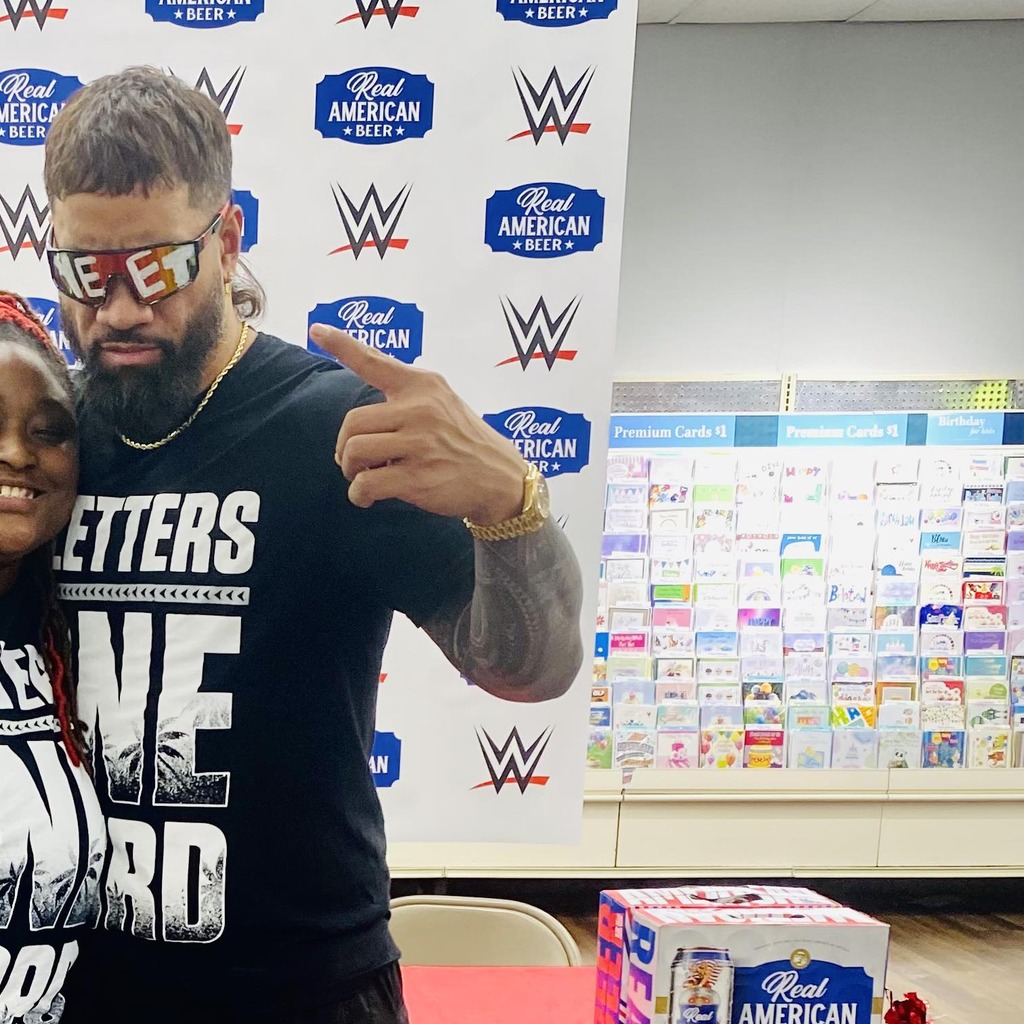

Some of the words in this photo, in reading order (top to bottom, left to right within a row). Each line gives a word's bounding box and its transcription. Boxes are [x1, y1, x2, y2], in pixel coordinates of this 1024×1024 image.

[186, 7, 223, 20] BEER
[537, 7, 575, 19] BEER
[346, 70, 404, 101] Real
[328, 100, 420, 122] AMERICAN
[9, 126, 46, 139] BEER
[355, 124, 393, 137] BEER
[516, 186, 574, 217] Real
[498, 216, 591, 237] AMERICAN
[525, 239, 562, 252] BEER
[337, 300, 395, 329] Real
[504, 410, 562, 438] Real
[938, 415, 986, 428] Birthday
[614, 426, 672, 439] Premium
[675, 425, 712, 439] Cards
[715, 424, 727, 438] $1
[786, 425, 844, 439] Premium
[847, 425, 884, 438] Cards
[887, 424, 899, 437] $1
[510, 438, 577, 458] ERICAN
[53, 491, 260, 573] ETTERS
[761, 970, 829, 1003] Real
[682, 1007, 713, 1023] Real
